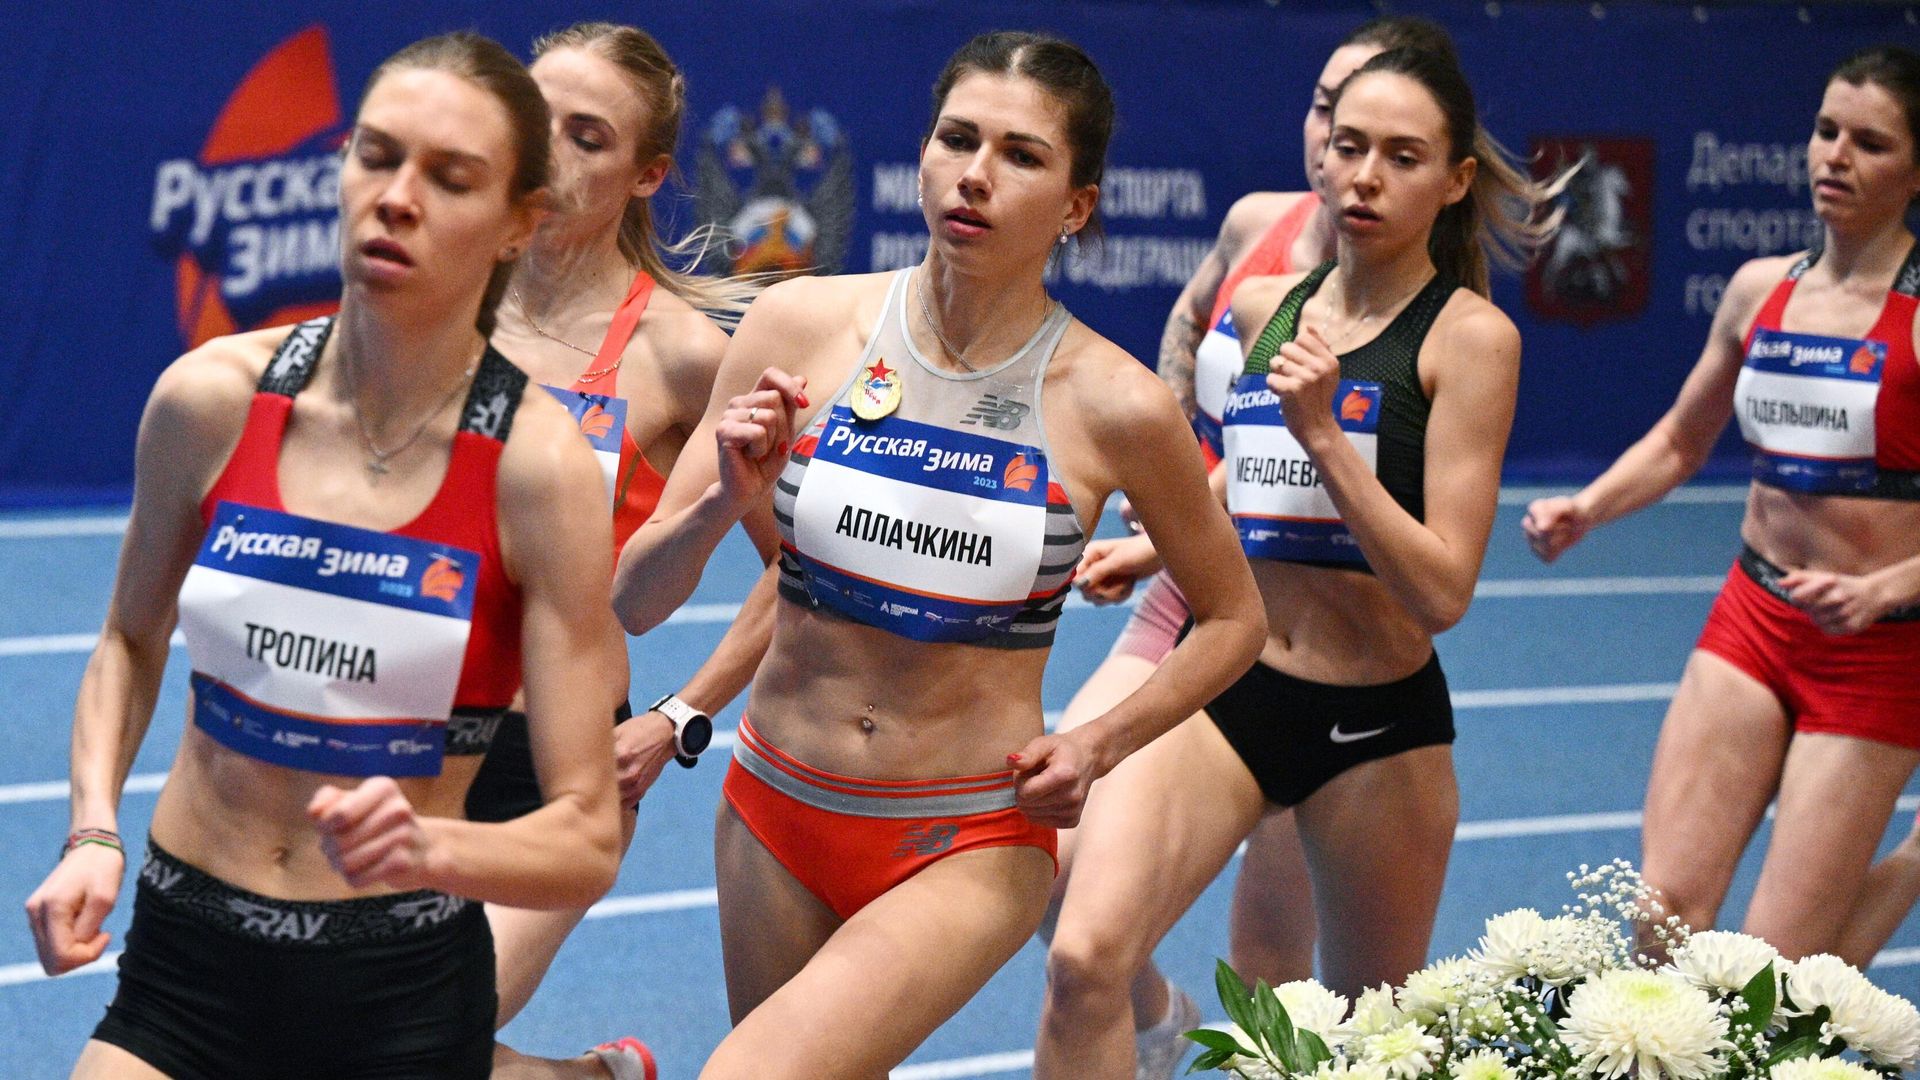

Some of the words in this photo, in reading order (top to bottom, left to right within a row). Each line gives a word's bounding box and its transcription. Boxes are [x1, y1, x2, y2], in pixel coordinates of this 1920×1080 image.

[151, 154, 341, 245] Русска
[827, 426, 928, 457] Русская
[973, 476, 998, 490] 2023
[211, 526, 322, 561] Русская
[836, 505, 993, 567] АПЛАЧКИНА
[245, 622, 377, 684] ТРОПИНА
[228, 898, 329, 941] RAY
